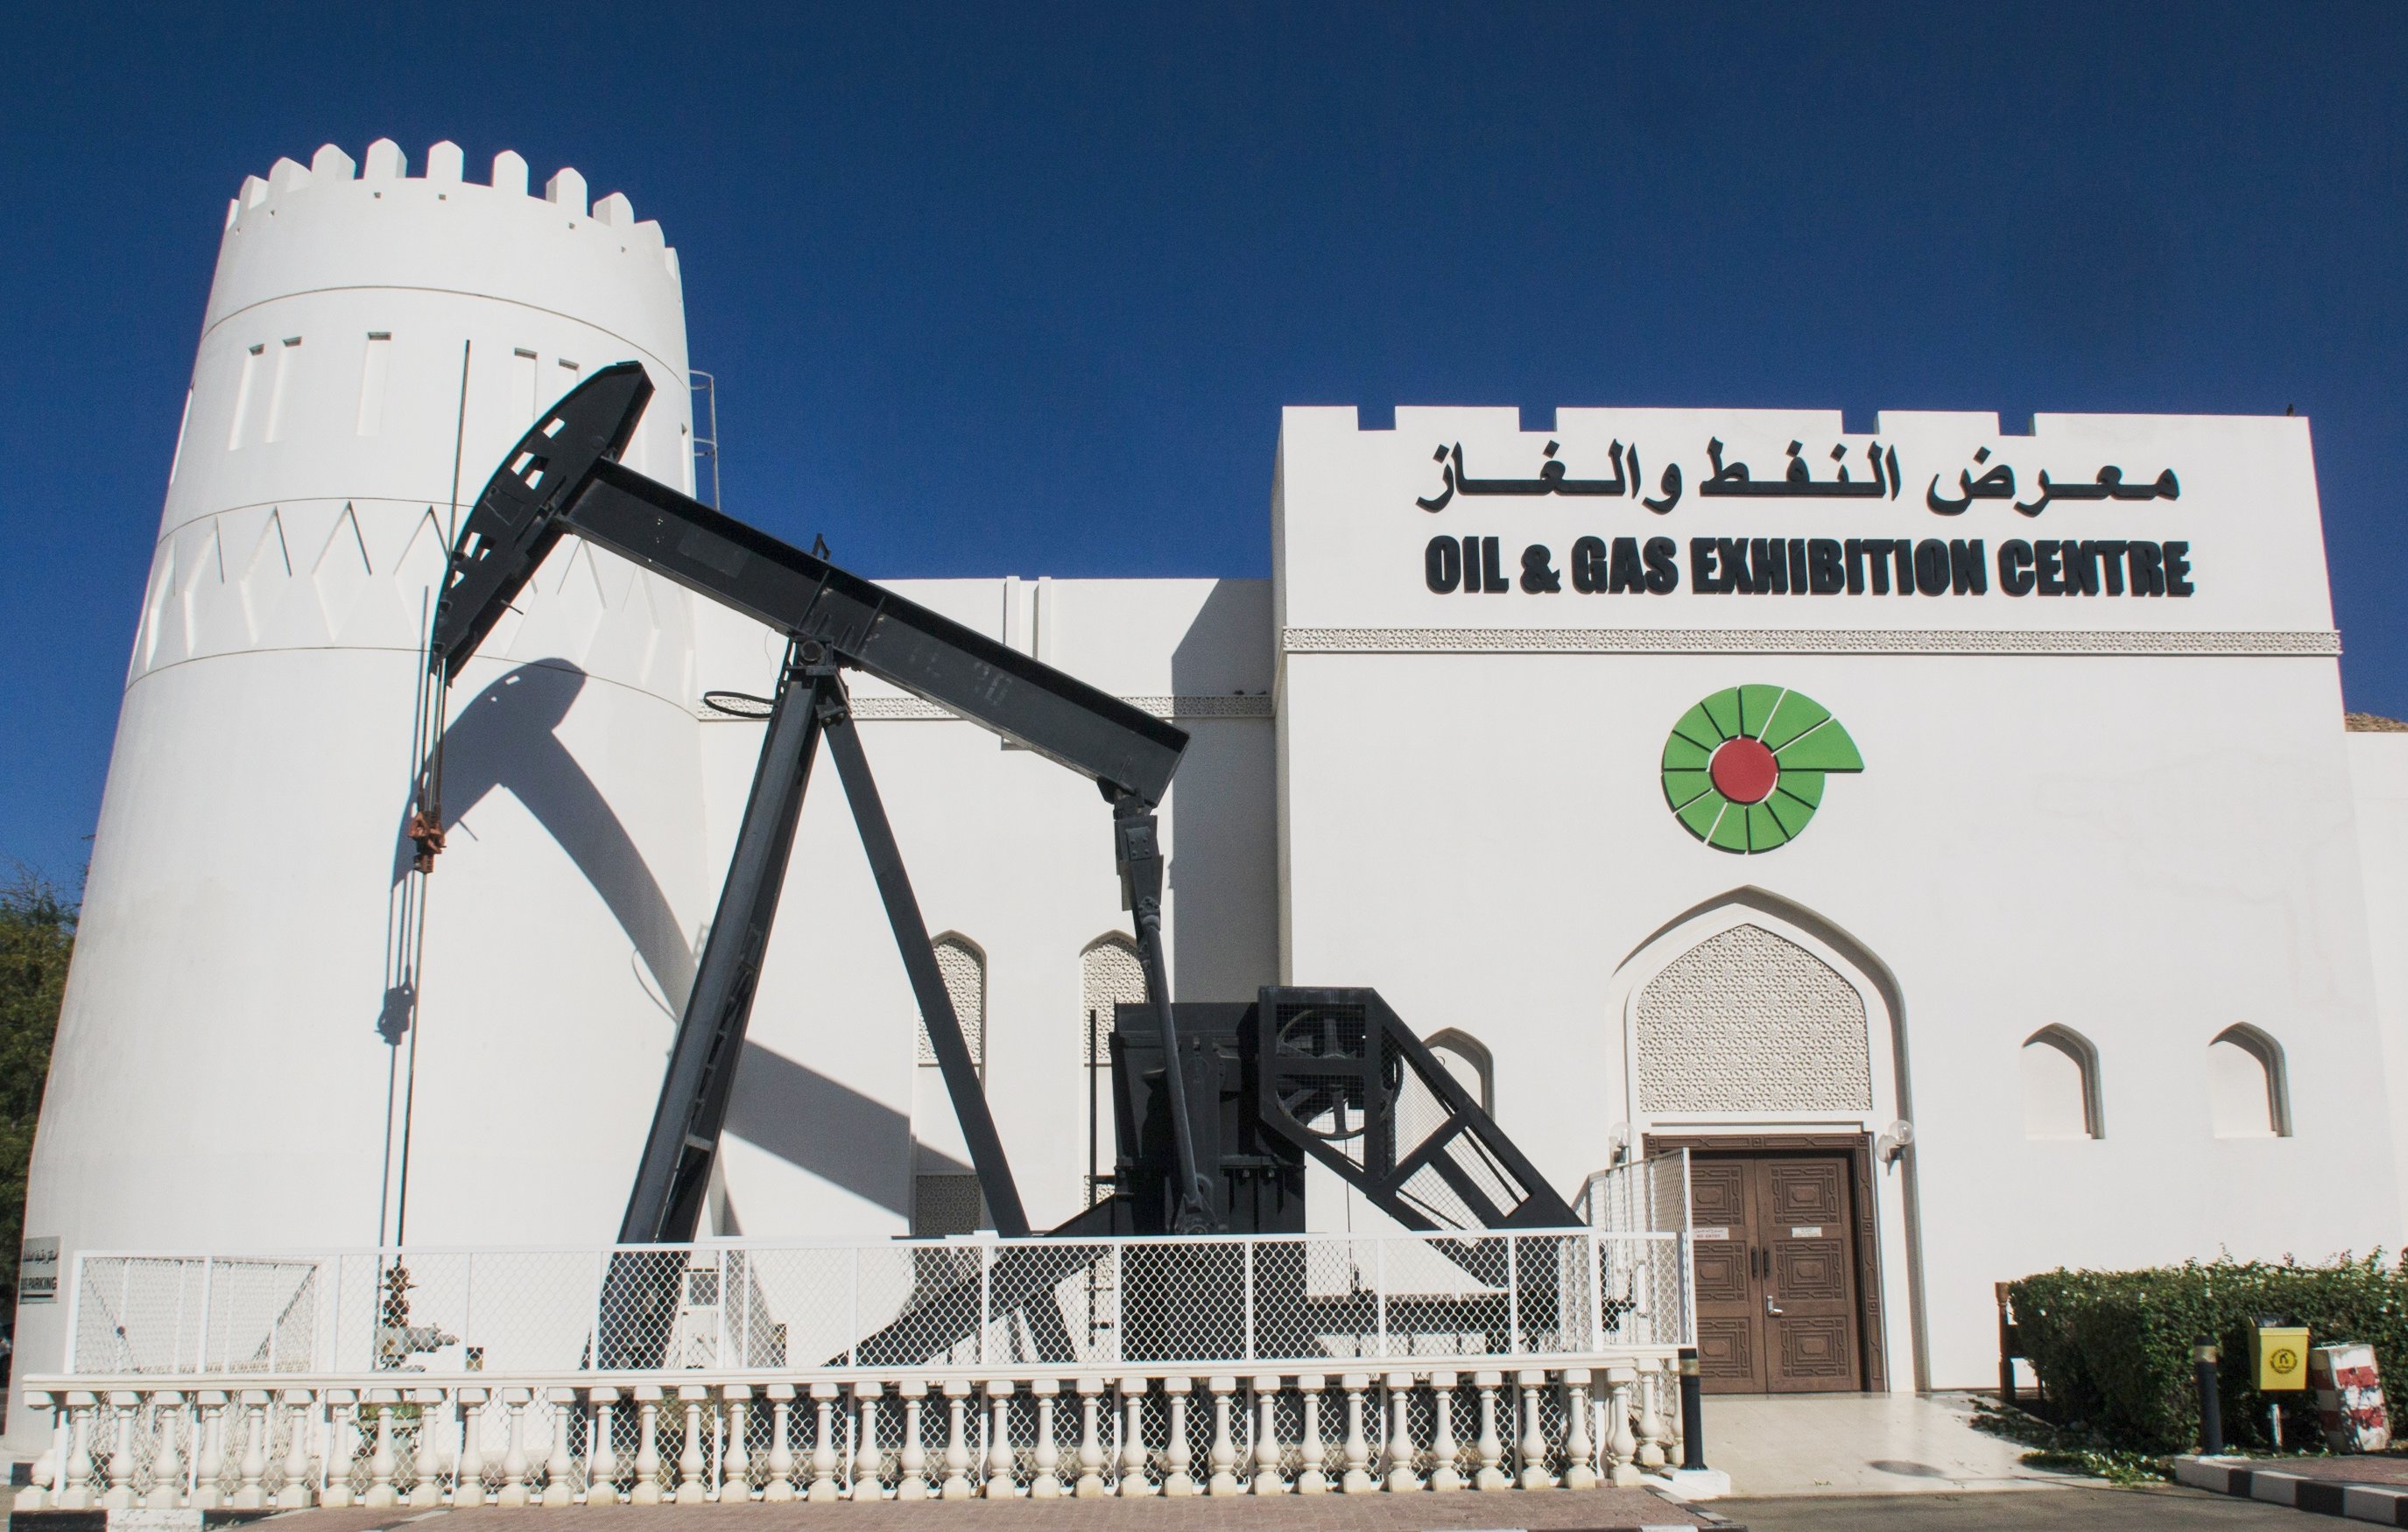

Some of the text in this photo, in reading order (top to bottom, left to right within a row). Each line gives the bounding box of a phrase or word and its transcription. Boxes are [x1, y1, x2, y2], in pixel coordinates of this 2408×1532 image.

[1415, 437, 2180, 518] معرض النفط والغاز
[1425, 535, 2194, 598] OIL & GAS EXHIBITION CENTRE
[29, 1276, 57, 1290] PARKING
